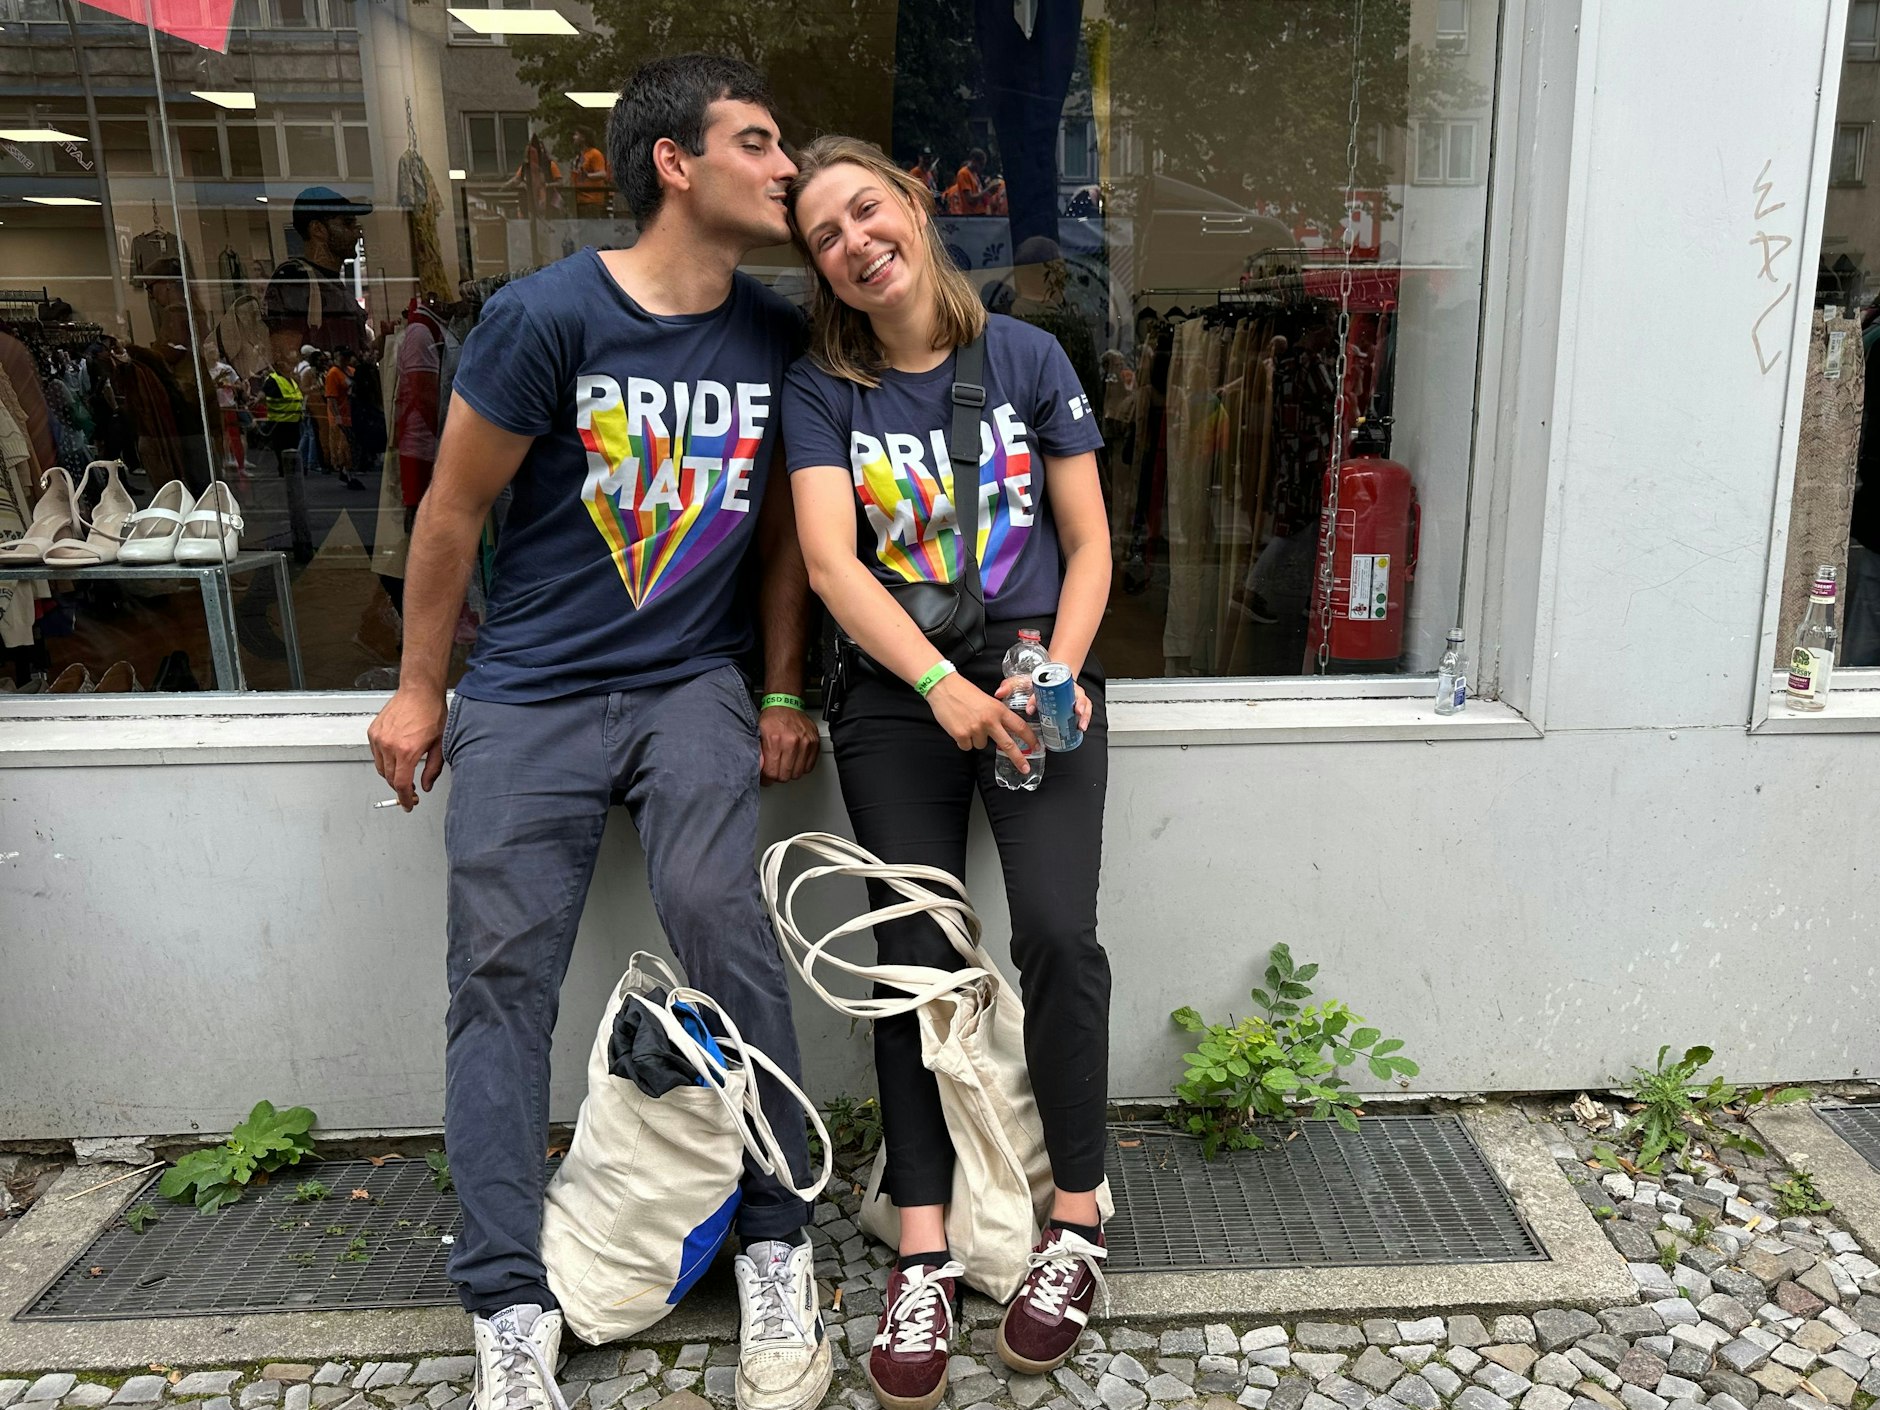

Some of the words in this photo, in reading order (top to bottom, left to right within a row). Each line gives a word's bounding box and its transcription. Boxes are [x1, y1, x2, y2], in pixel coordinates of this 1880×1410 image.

[576, 374, 772, 439] PRIDE
[580, 451, 756, 512] MATE
[766, 696, 783, 704] CSD
